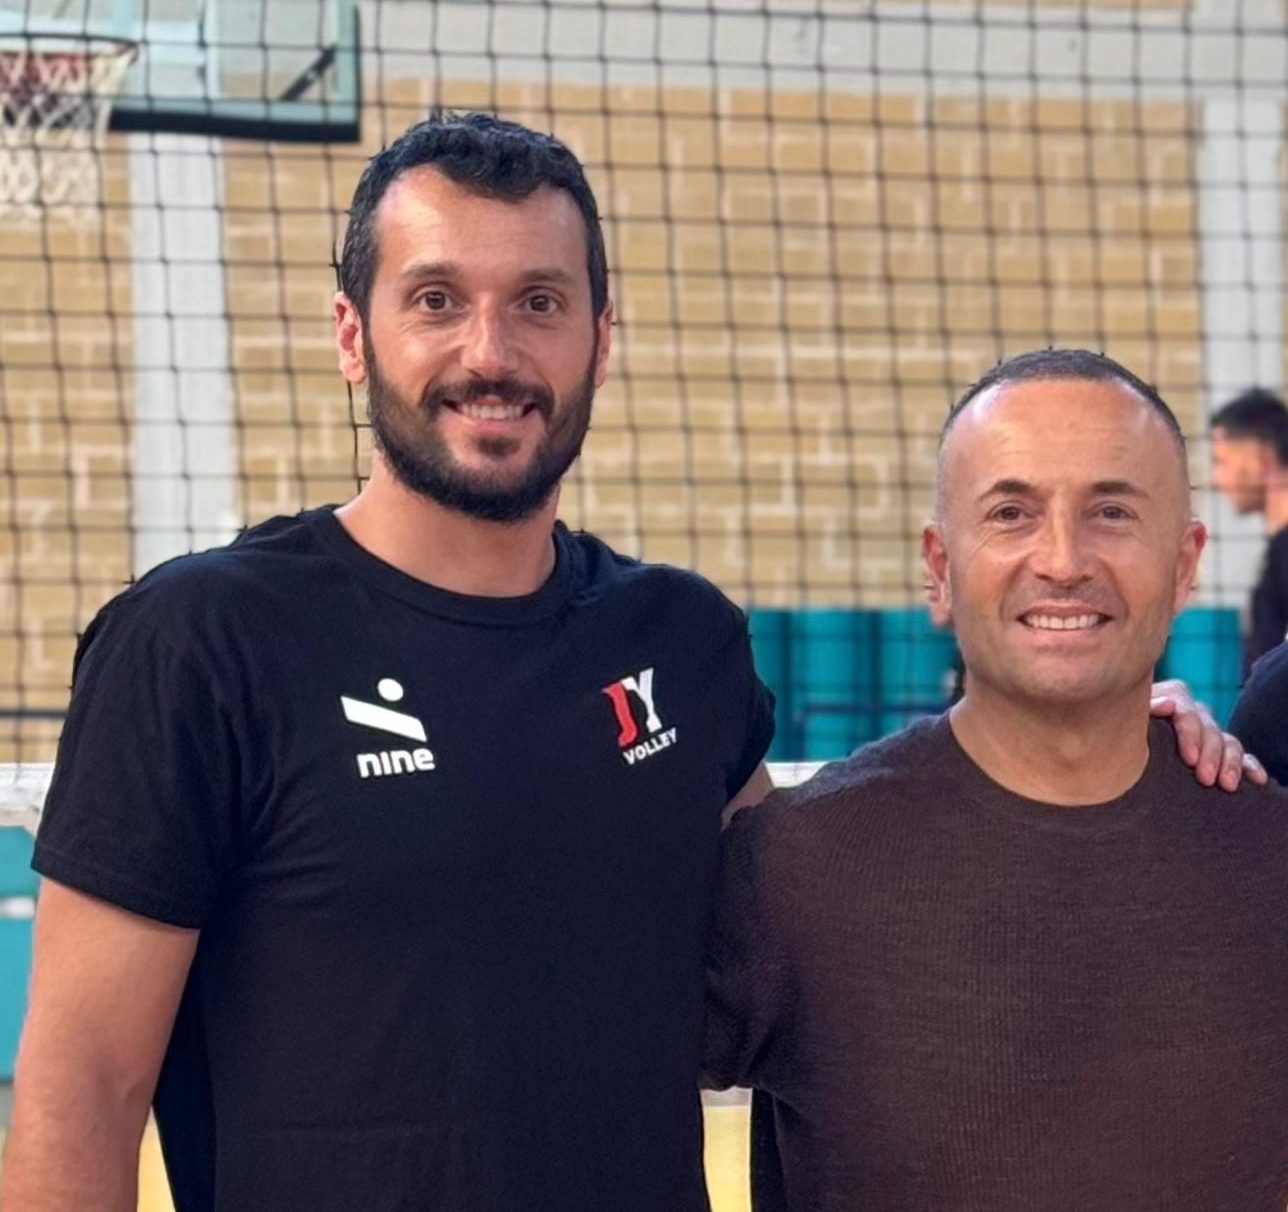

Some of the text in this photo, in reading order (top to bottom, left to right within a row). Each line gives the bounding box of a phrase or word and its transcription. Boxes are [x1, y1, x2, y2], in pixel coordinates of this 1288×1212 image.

[601, 667, 663, 747] JY
[356, 748, 435, 778] nine
[622, 727, 677, 765] VOLLEY
